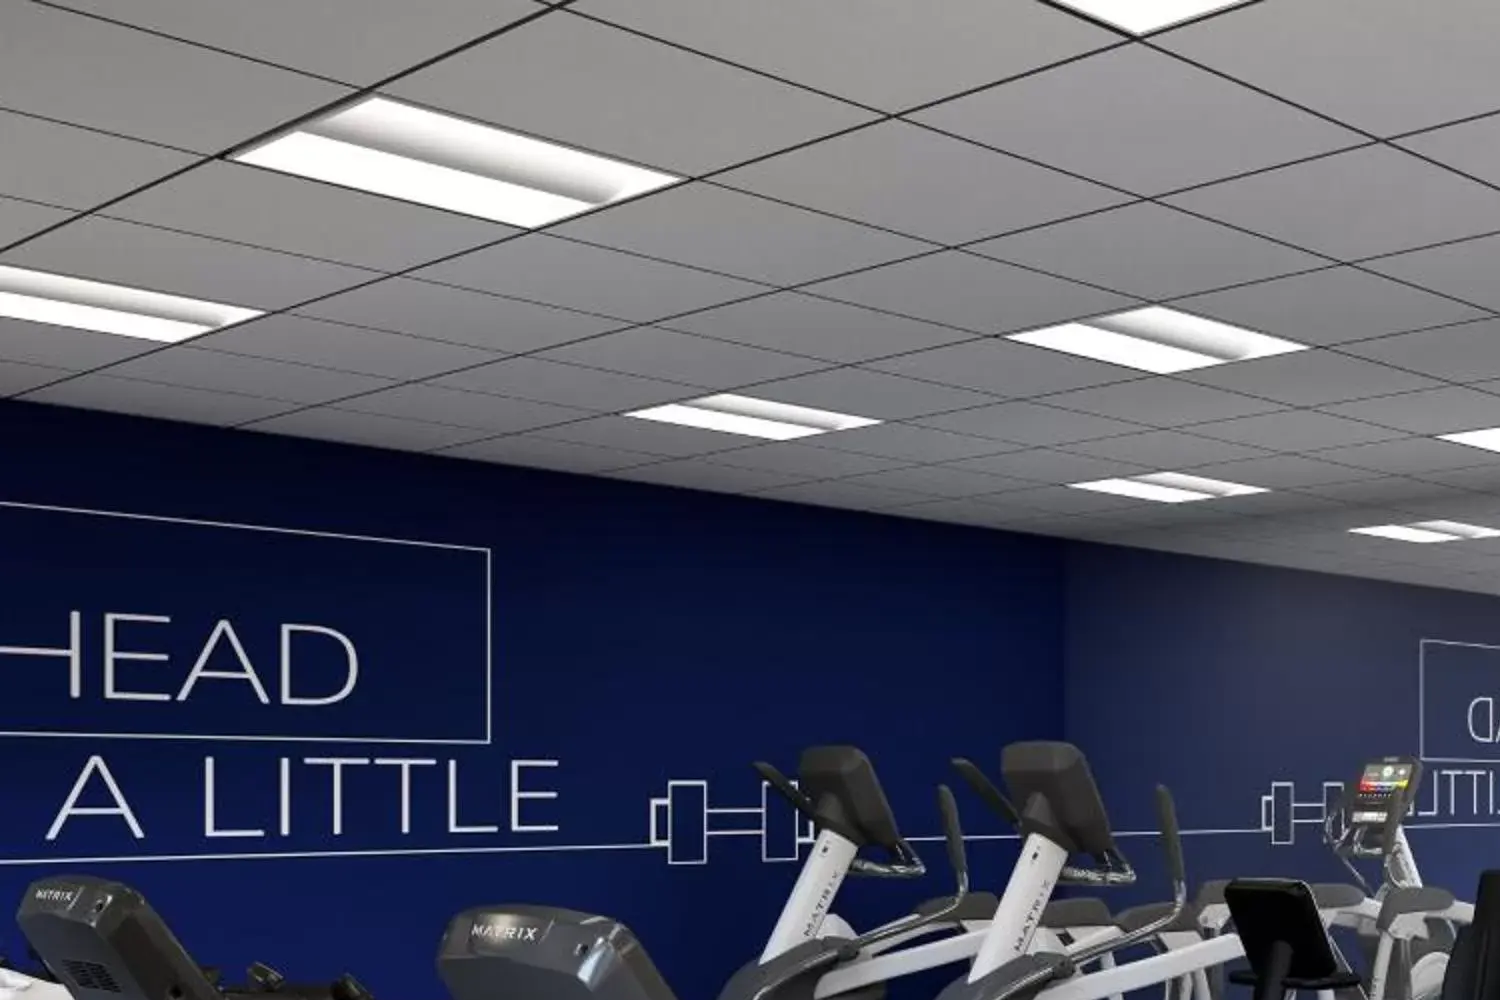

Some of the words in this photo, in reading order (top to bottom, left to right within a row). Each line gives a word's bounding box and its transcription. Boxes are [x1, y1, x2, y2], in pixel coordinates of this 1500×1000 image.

[45, 754, 145, 840] A
[205, 756, 560, 838] LITTLE
[470, 923, 539, 942] MATRIX
